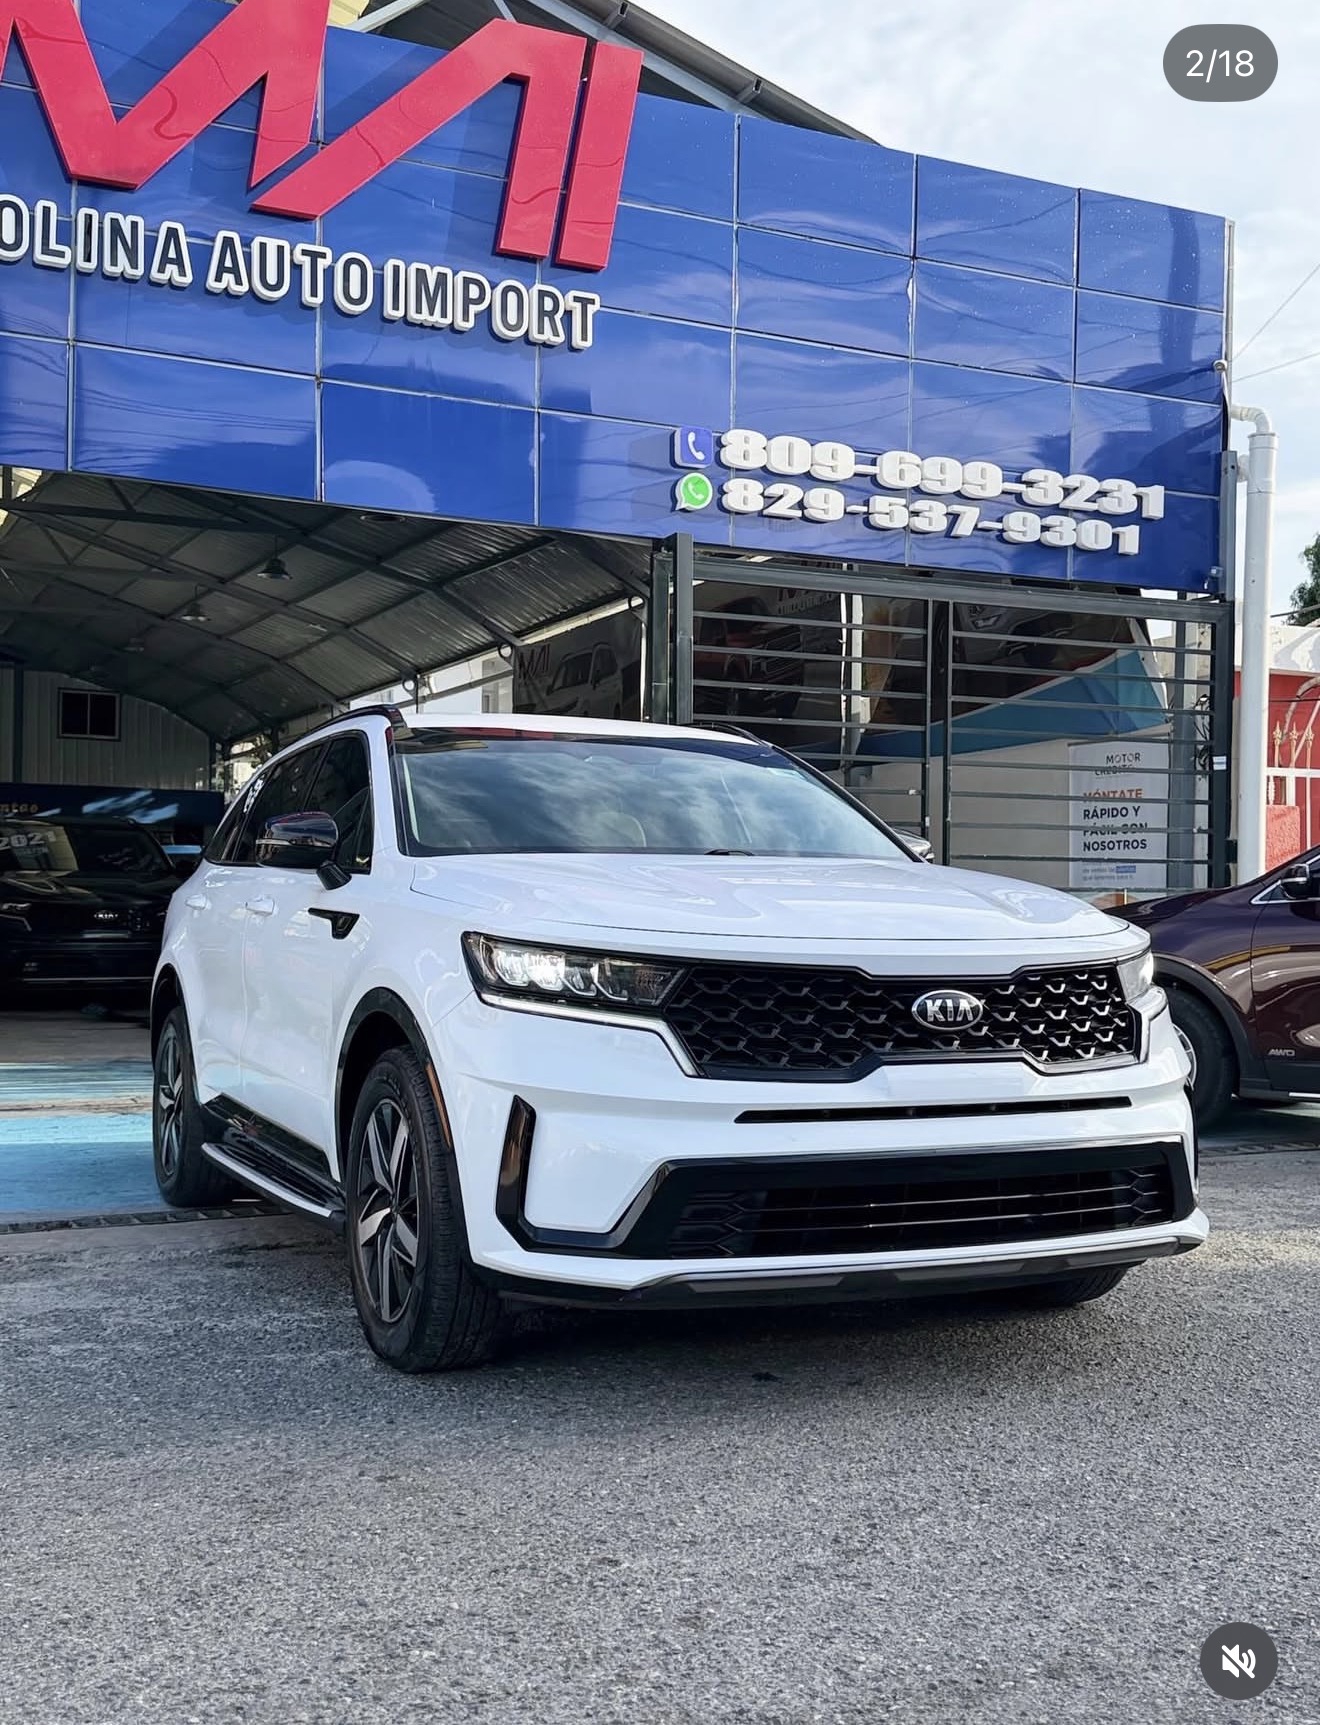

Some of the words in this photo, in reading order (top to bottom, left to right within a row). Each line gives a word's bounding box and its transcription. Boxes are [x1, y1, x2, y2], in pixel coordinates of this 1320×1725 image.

[206, 230, 374, 315] AUTO
[383, 258, 601, 350] IMPORT
[720, 428, 1165, 520] 809-699-3231
[721, 477, 1140, 556] 829-537-9301
[1106, 752, 1141, 765] MOTOR
[1083, 805, 1129, 820] RÁPIDO
[1132, 805, 1141, 818] Y
[1083, 839, 1148, 852] NOSOTROS
[925, 999, 974, 1022] KIA
[1267, 1048, 1296, 1057] AWD
